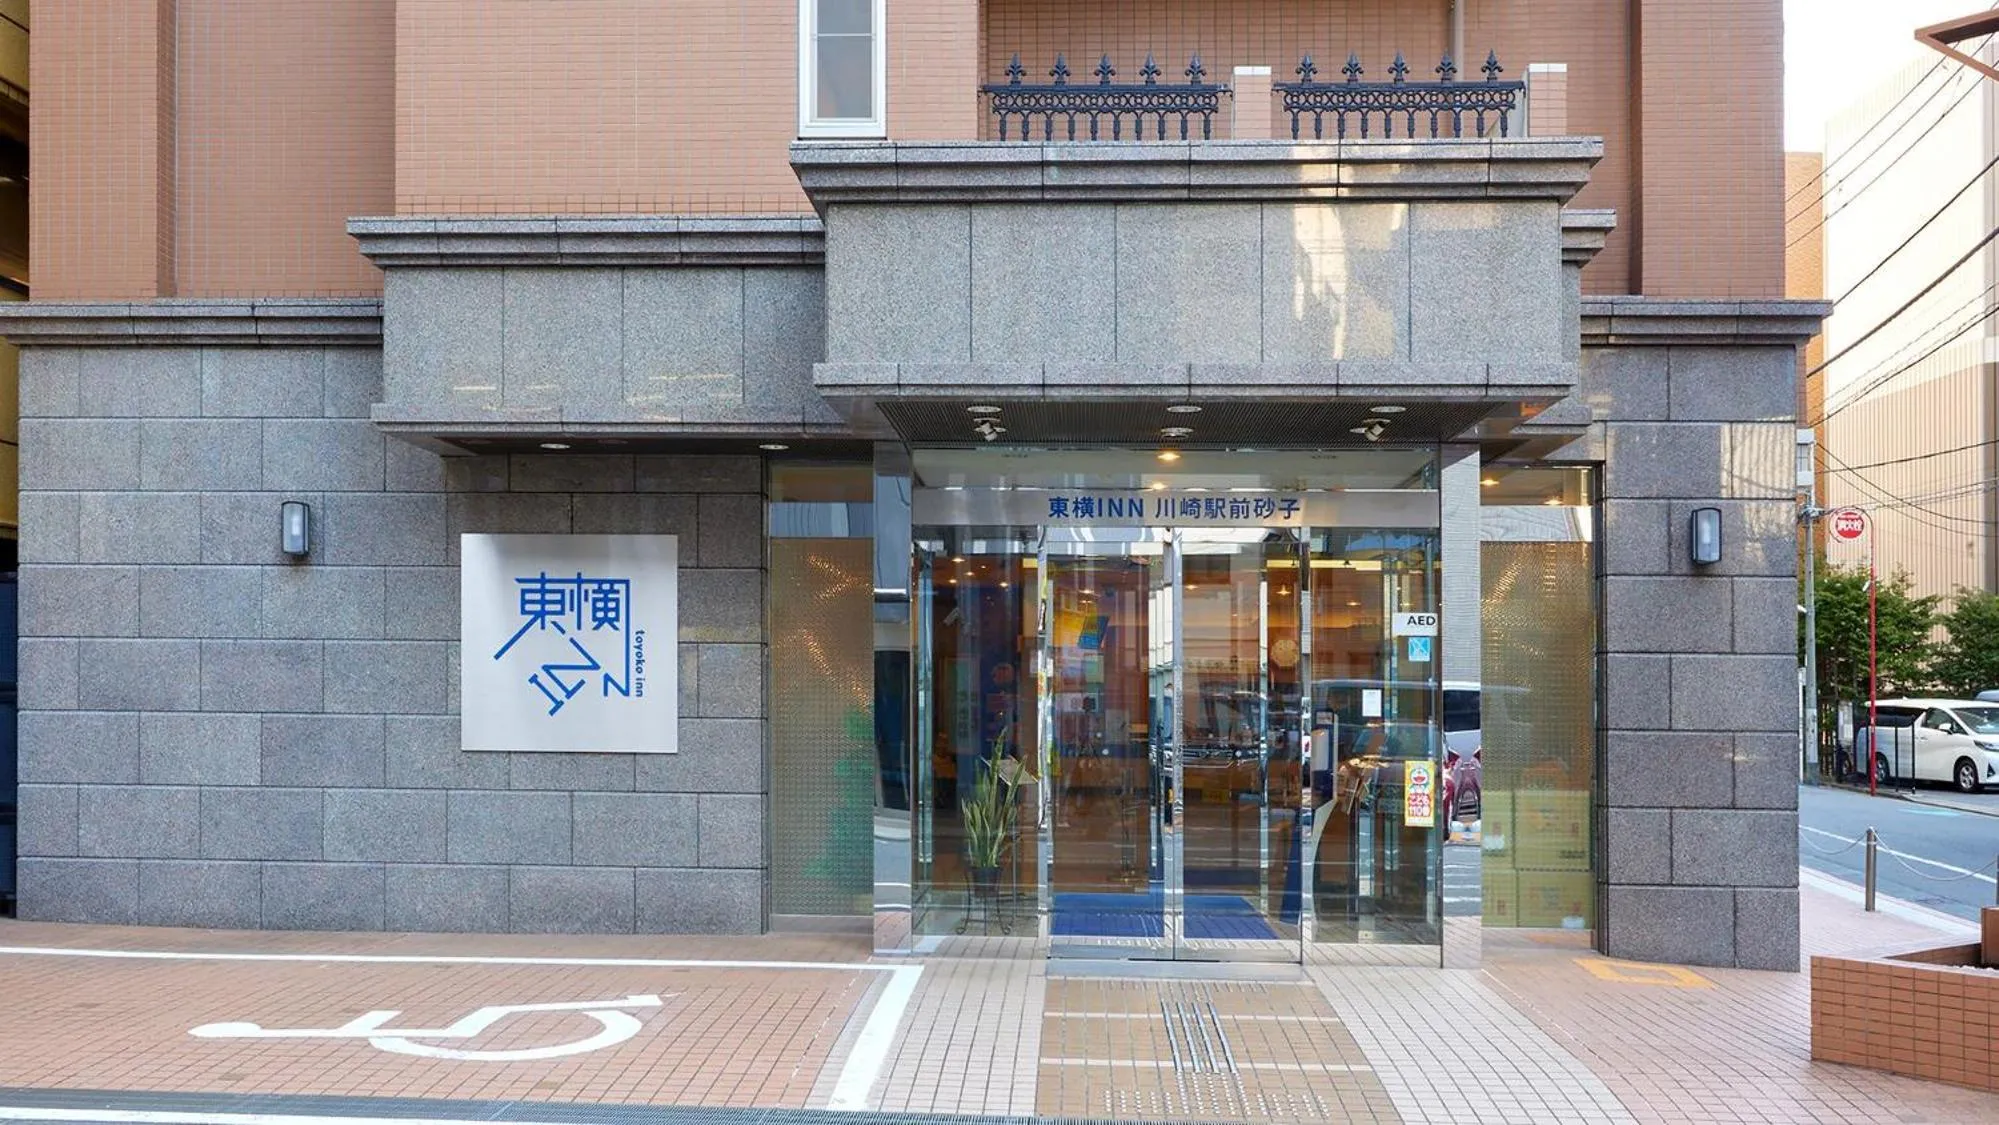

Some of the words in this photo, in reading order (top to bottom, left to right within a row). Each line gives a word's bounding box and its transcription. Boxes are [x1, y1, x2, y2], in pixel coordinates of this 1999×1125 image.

[1047, 496, 1144, 519] 東横INN
[1154, 496, 1300, 519] 川崎駅前砂子
[1406, 615, 1436, 626] AED
[633, 629, 646, 674] toyoko
[635, 677, 646, 697] inn
